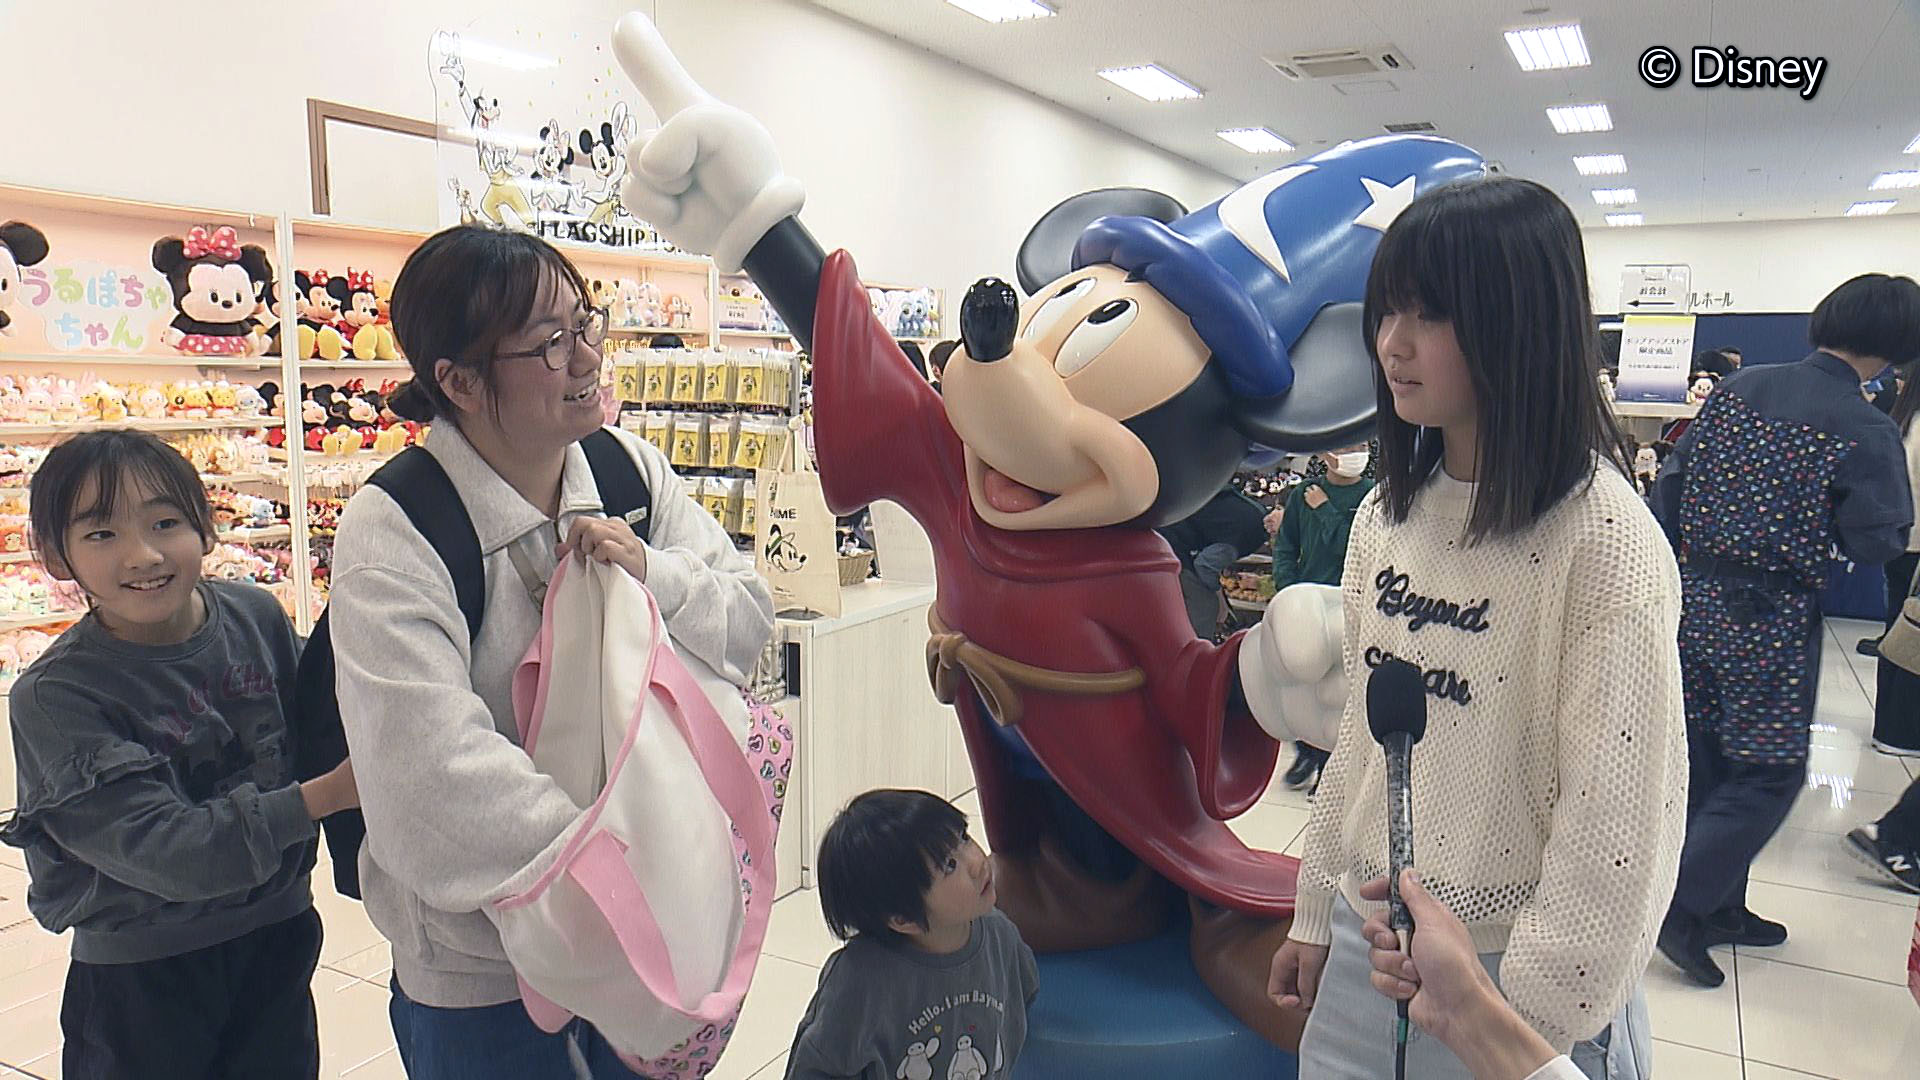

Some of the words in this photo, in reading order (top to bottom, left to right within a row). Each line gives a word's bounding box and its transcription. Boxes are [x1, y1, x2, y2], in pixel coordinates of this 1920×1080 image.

[539, 220, 646, 247] FLAGSHIP
[23, 267, 167, 309] うるぽちゃ
[54, 312, 144, 349] ちゃん
[1375, 565, 1490, 632] Beyond
[1364, 646, 1472, 706] care
[953, 993, 970, 1007] am
[972, 990, 1004, 1012] Bayma
